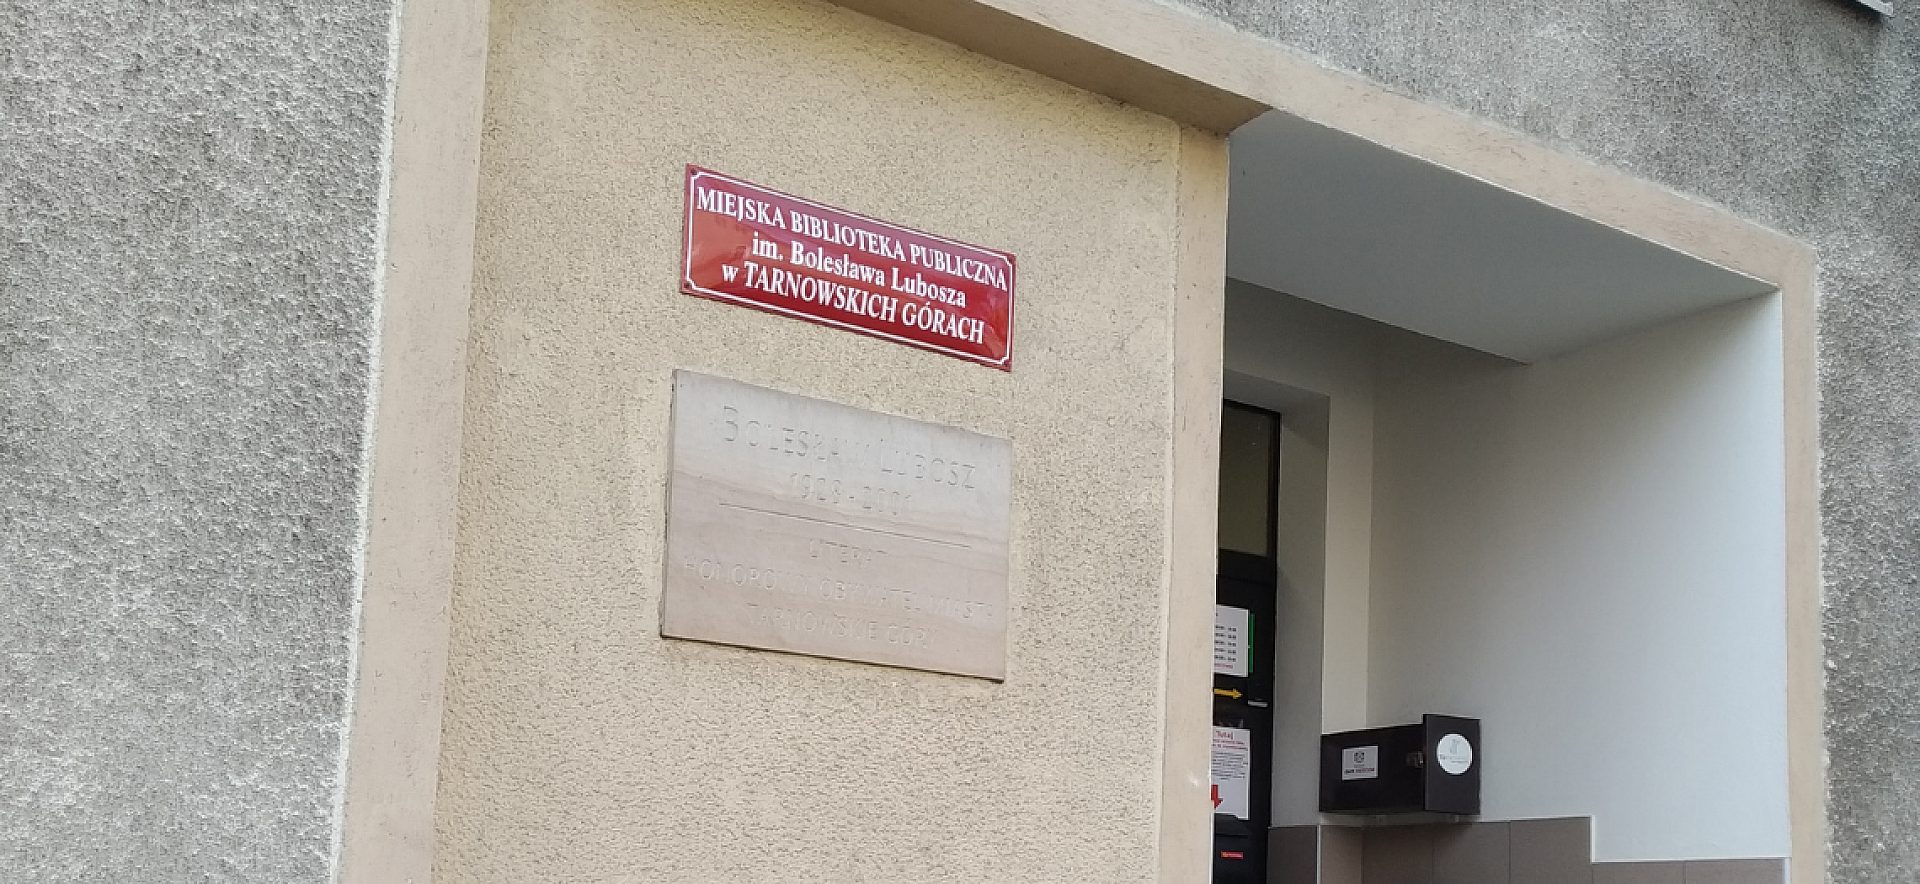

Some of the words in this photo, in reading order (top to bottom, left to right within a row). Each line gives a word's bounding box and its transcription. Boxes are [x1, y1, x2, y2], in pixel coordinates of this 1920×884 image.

[696, 186, 786, 229] MIEJSKA
[790, 209, 906, 262] BIBLIOTEKA
[910, 244, 1008, 292] PUBLICZNA
[752, 231, 784, 261] im.
[790, 240, 886, 287] Bolesława
[891, 267, 967, 308] Lubosza
[722, 263, 739, 283] w
[744, 260, 899, 323] TARNOWSKICH
[902, 301, 985, 345] GÓRACH
[880, 438, 976, 489] LUBOSZ
